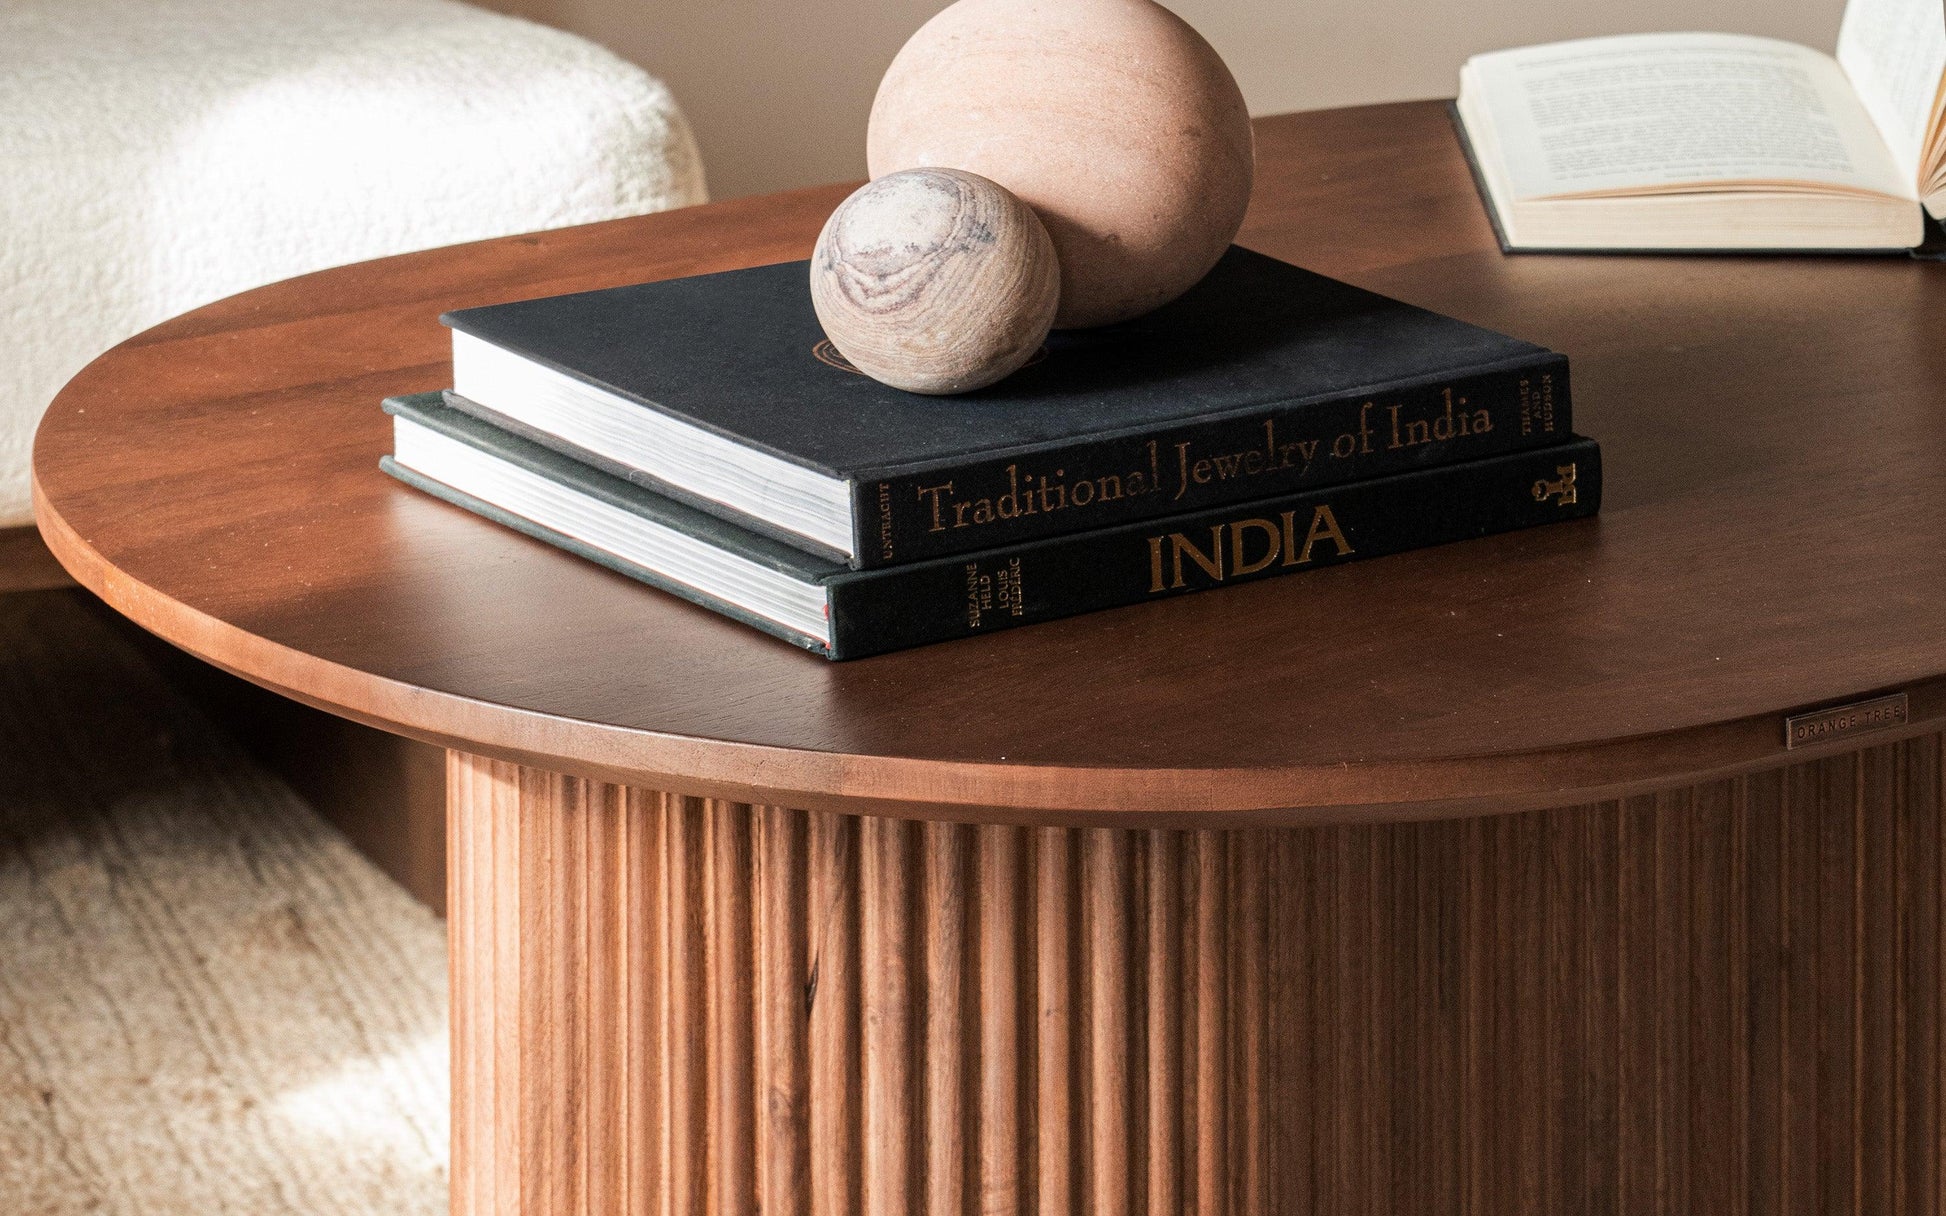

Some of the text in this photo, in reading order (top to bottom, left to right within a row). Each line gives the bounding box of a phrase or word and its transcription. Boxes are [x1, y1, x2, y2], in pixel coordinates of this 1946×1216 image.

[1519, 379, 1531, 435] THAMES
[1532, 391, 1542, 419] AND
[1542, 374, 1554, 432] HUDSON
[917, 387, 1494, 534] Traditional Jewelry of India
[879, 483, 893, 560] UNTRACHT
[1146, 504, 1355, 593] INDIA
[966, 562, 981, 629] SUZANNE
[980, 575, 992, 610] HELD
[997, 569, 1009, 609] LOUIS
[1797, 705, 1901, 739] ORANGE TREE
